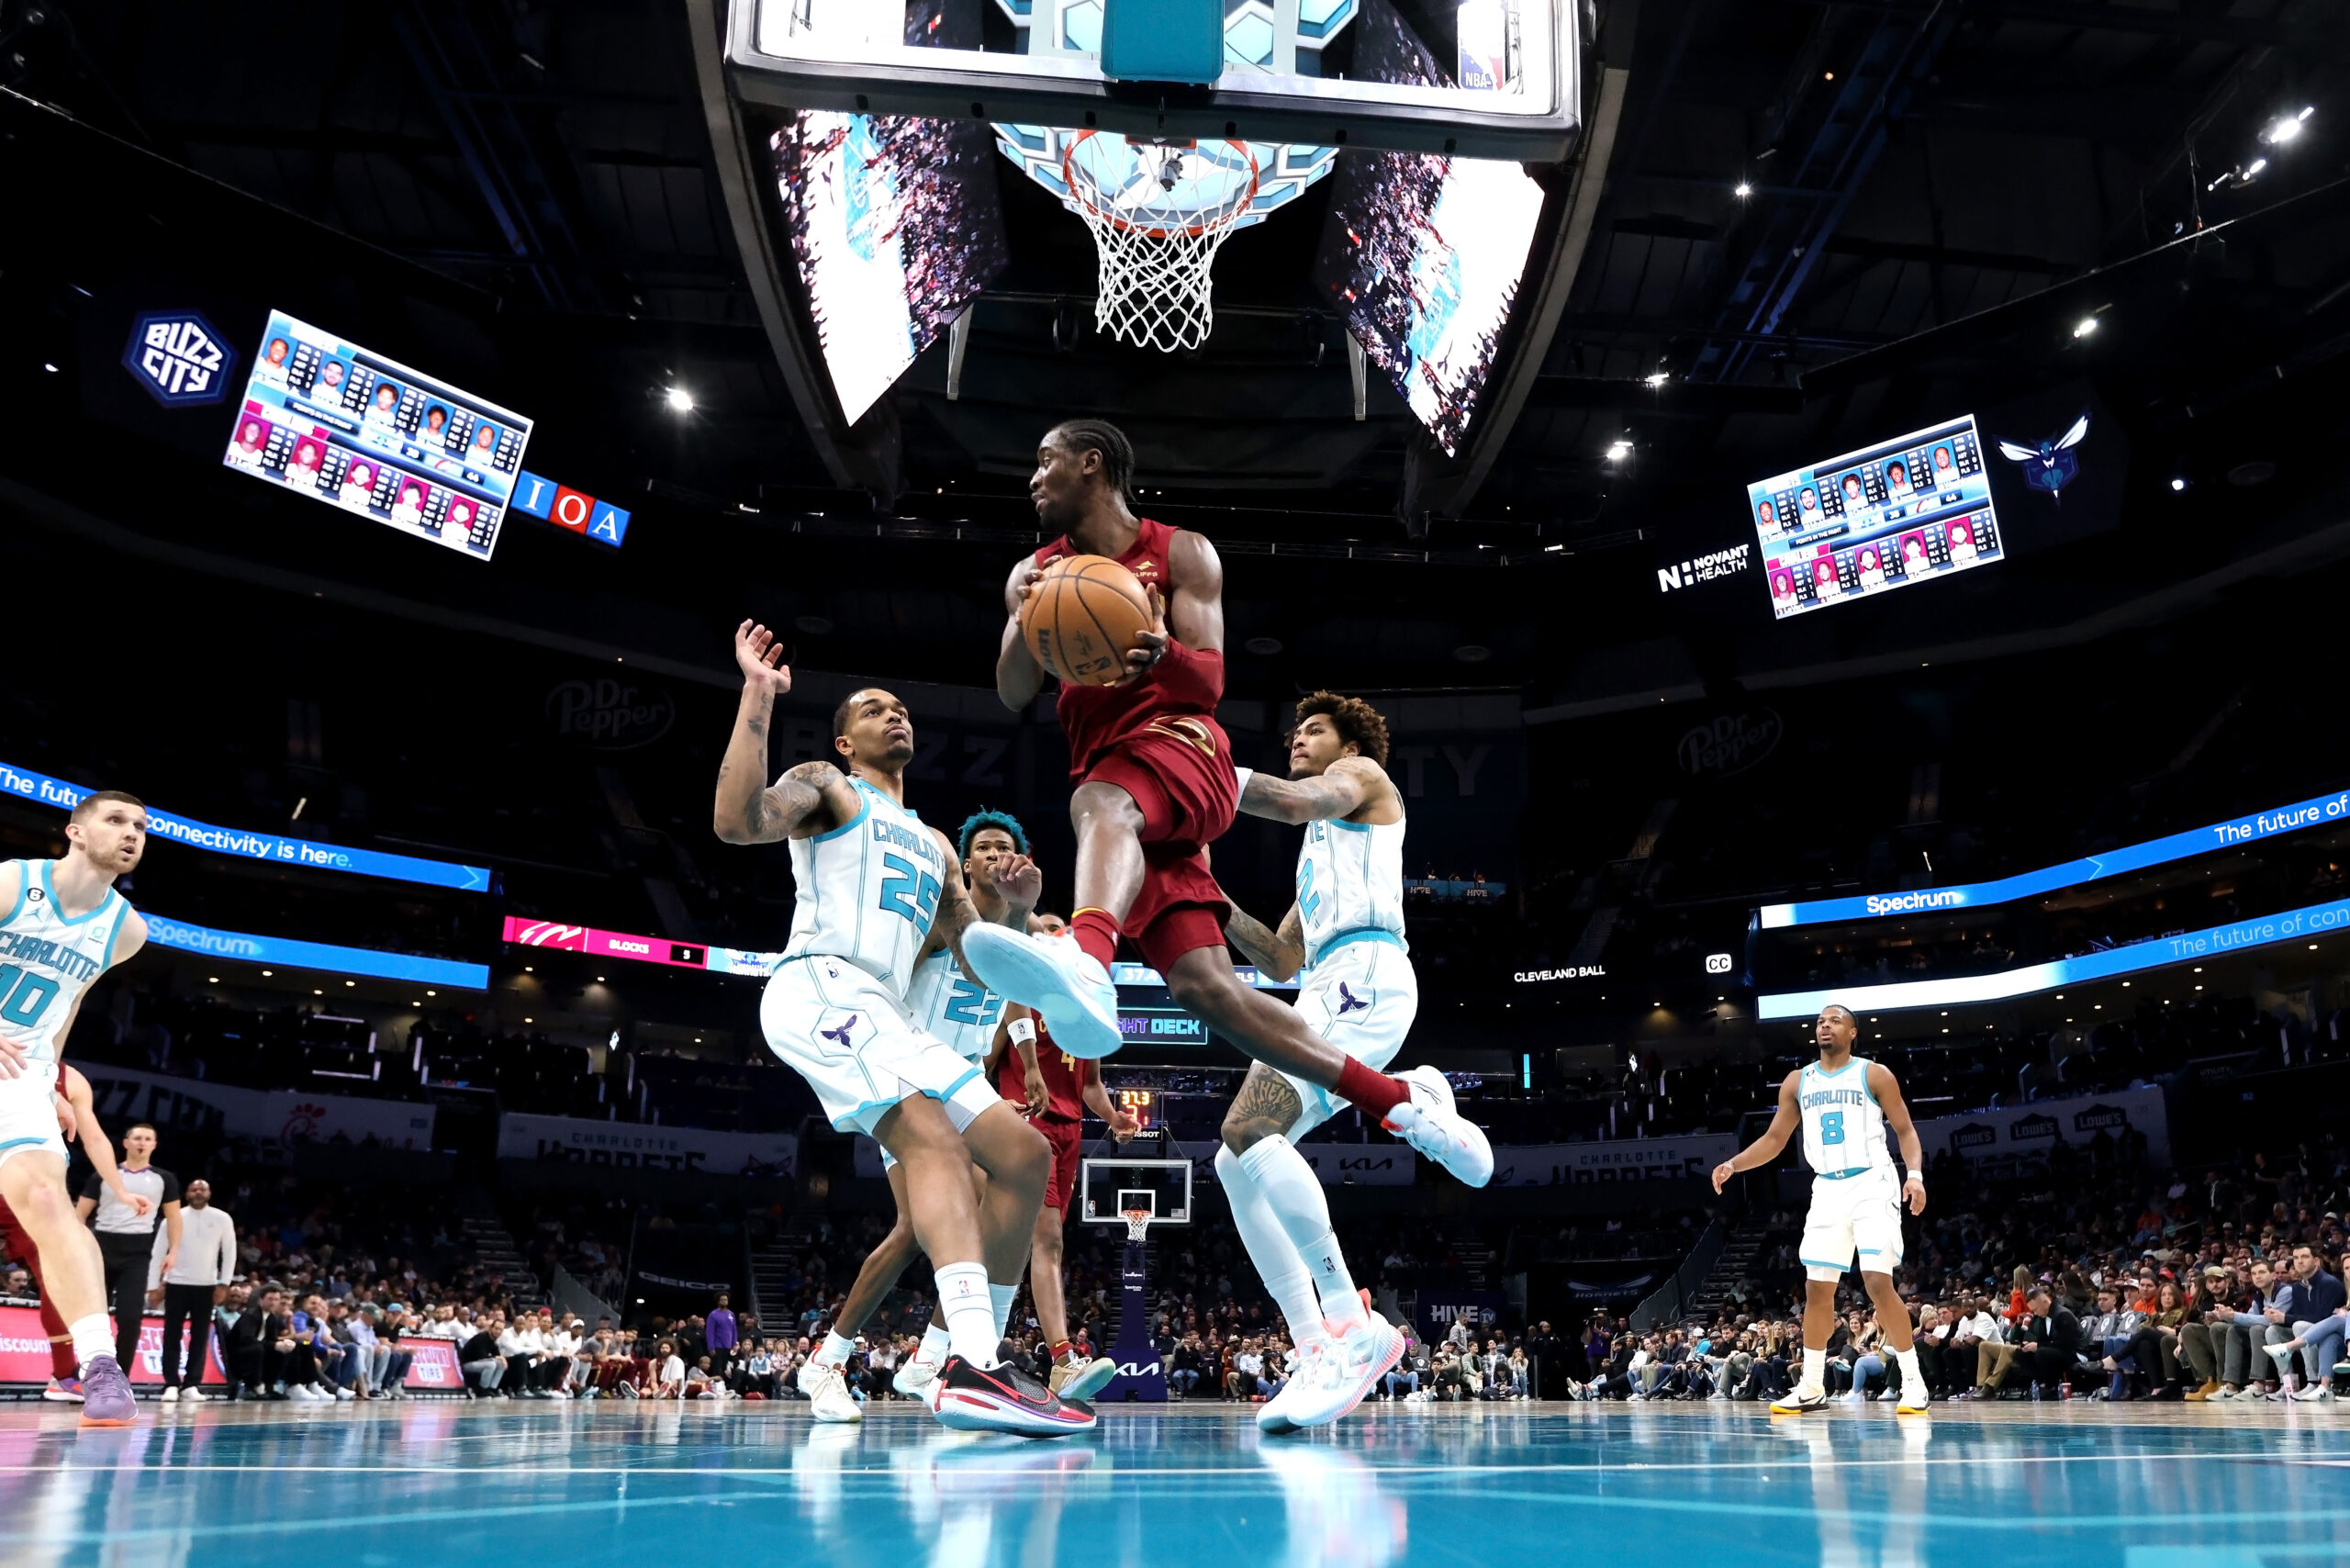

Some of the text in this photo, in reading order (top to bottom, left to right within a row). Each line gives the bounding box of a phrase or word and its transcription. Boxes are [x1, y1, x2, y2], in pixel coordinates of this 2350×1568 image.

[1465, 72, 1487, 88] NBA
[145, 321, 223, 372] BUZZ
[141, 347, 211, 393] CITY
[1795, 535, 1812, 544] POINTS
[1828, 526, 1841, 535] PAINT
[1693, 543, 1750, 570] NOVANT
[1695, 557, 1748, 583] HEALTH
[594, 678, 639, 708] Dr
[557, 683, 668, 740] Pepper
[1713, 711, 1750, 740] Dr
[1685, 718, 1776, 777] Pepper
[0, 767, 352, 868] The futu connectivity is here.
[2214, 794, 2350, 845] The future of
[29, 889, 43, 902] 6
[879, 851, 943, 938] 25
[1466, 889, 1488, 897] HIVE
[1865, 890, 1957, 916] Spectrum
[147, 918, 256, 957] Spectrum
[609, 939, 650, 954] BLOCKS
[2169, 935, 2209, 958] The
[2211, 922, 2276, 953] future
[2280, 912, 2303, 935] of
[0, 930, 101, 983] CHARLOTTE
[1709, 957, 1729, 970] CC
[1514, 965, 1606, 983] CLEVELAND BALL
[0, 962, 61, 1028] 10
[945, 979, 1006, 1026] 23
[1150, 1019, 1201, 1035] DECK
[1121, 1091, 1150, 1105] 37.3
[1802, 1089, 1863, 1111] CHARLOTTE
[1820, 1111, 1845, 1145] 8
[2014, 1122, 2056, 1138] LOWE'S
[2078, 1112, 2123, 1128] LOWE'S
[572, 1132, 679, 1150] CHARLOTTE
[1953, 1130, 1993, 1146] LOWE'S
[1580, 1149, 1677, 1165] CHARLOTTE
[1430, 1305, 1479, 1323] HIVE
[0, 1337, 50, 1353] iscoun
